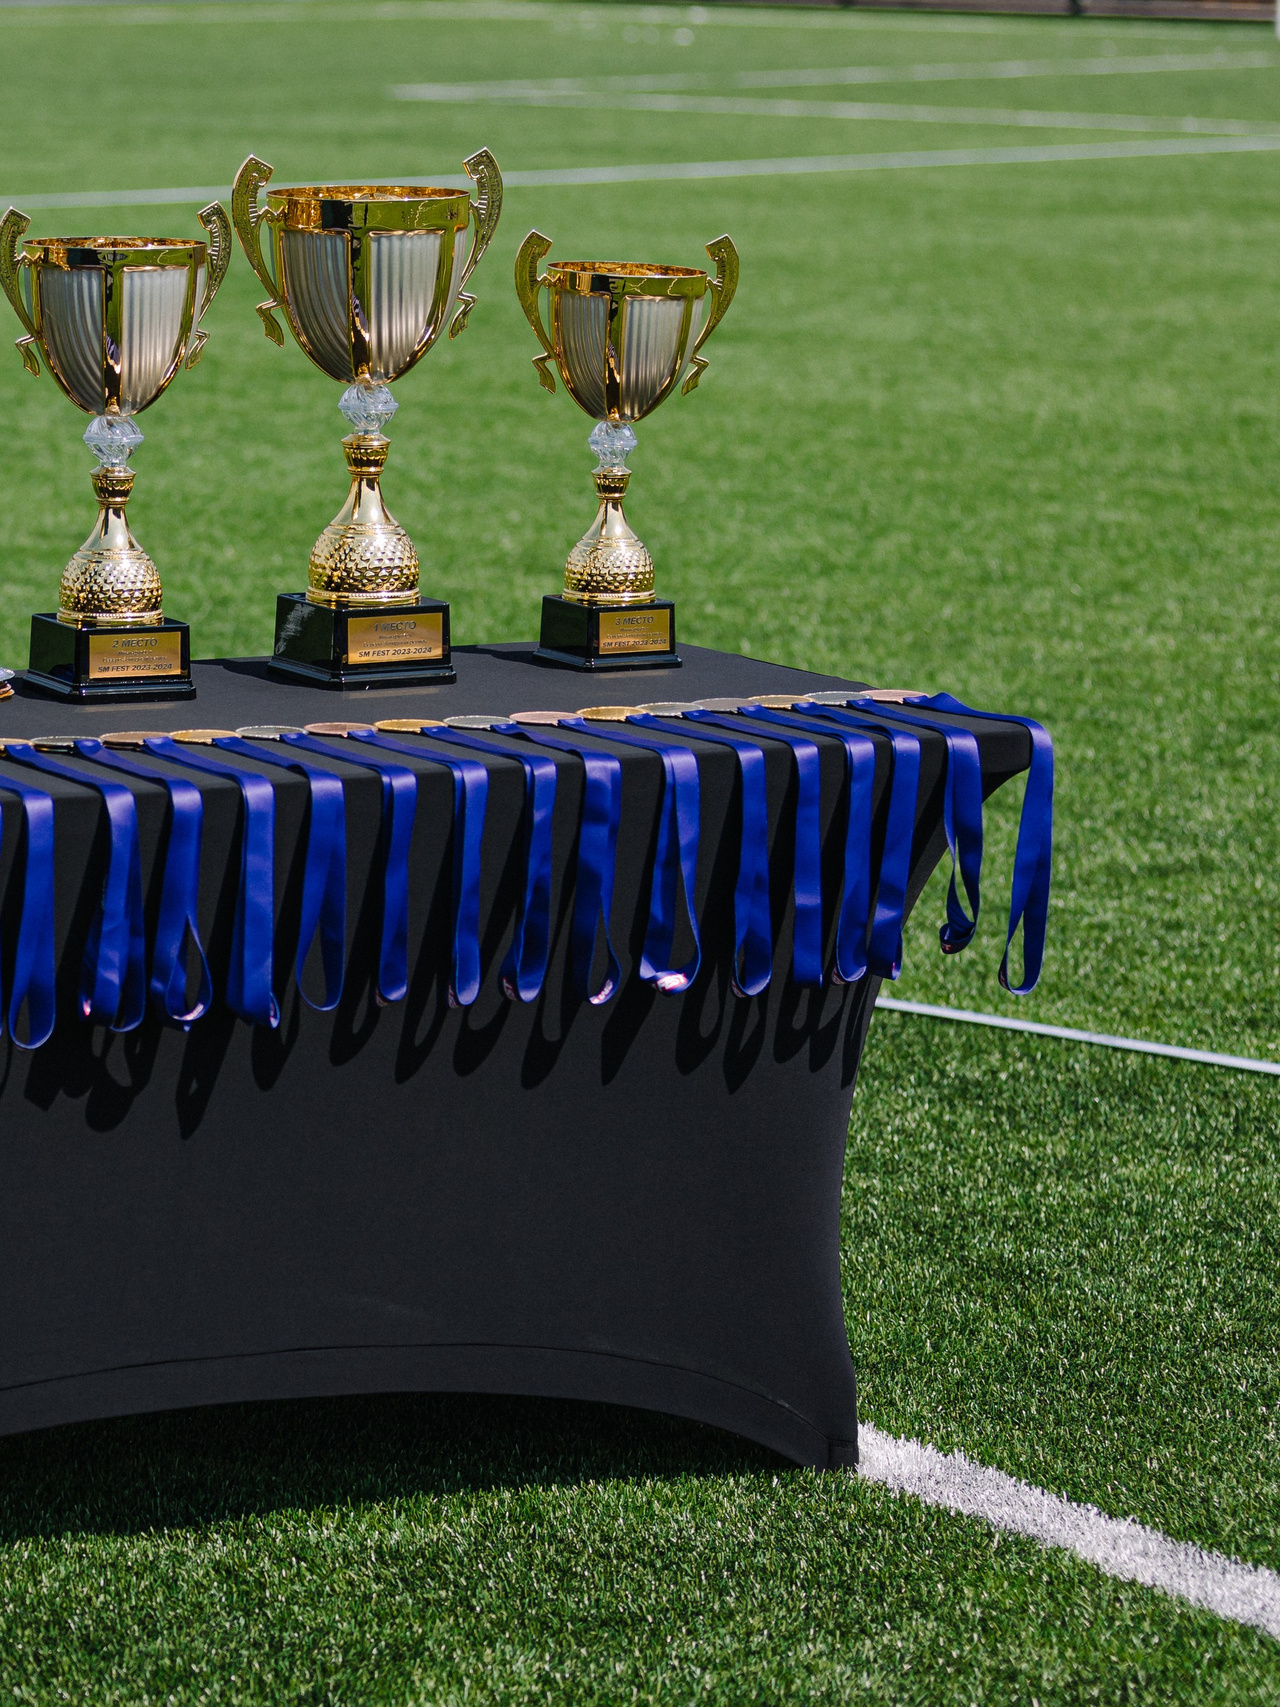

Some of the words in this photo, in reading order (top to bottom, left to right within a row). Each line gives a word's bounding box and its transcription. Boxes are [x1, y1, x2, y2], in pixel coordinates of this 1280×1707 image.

[615, 617, 621, 626] 3
[623, 615, 654, 625] МЕСТО
[374, 623, 379, 632] 1
[381, 621, 417, 632] МЕСТО
[112, 640, 118, 648] 2
[121, 638, 158, 648] МЕСТО
[358, 650, 370, 658] SM
[372, 649, 390, 657] FEST
[392, 647, 432, 656] 2023-2024
[132, 663, 173, 671] 2023-2024
